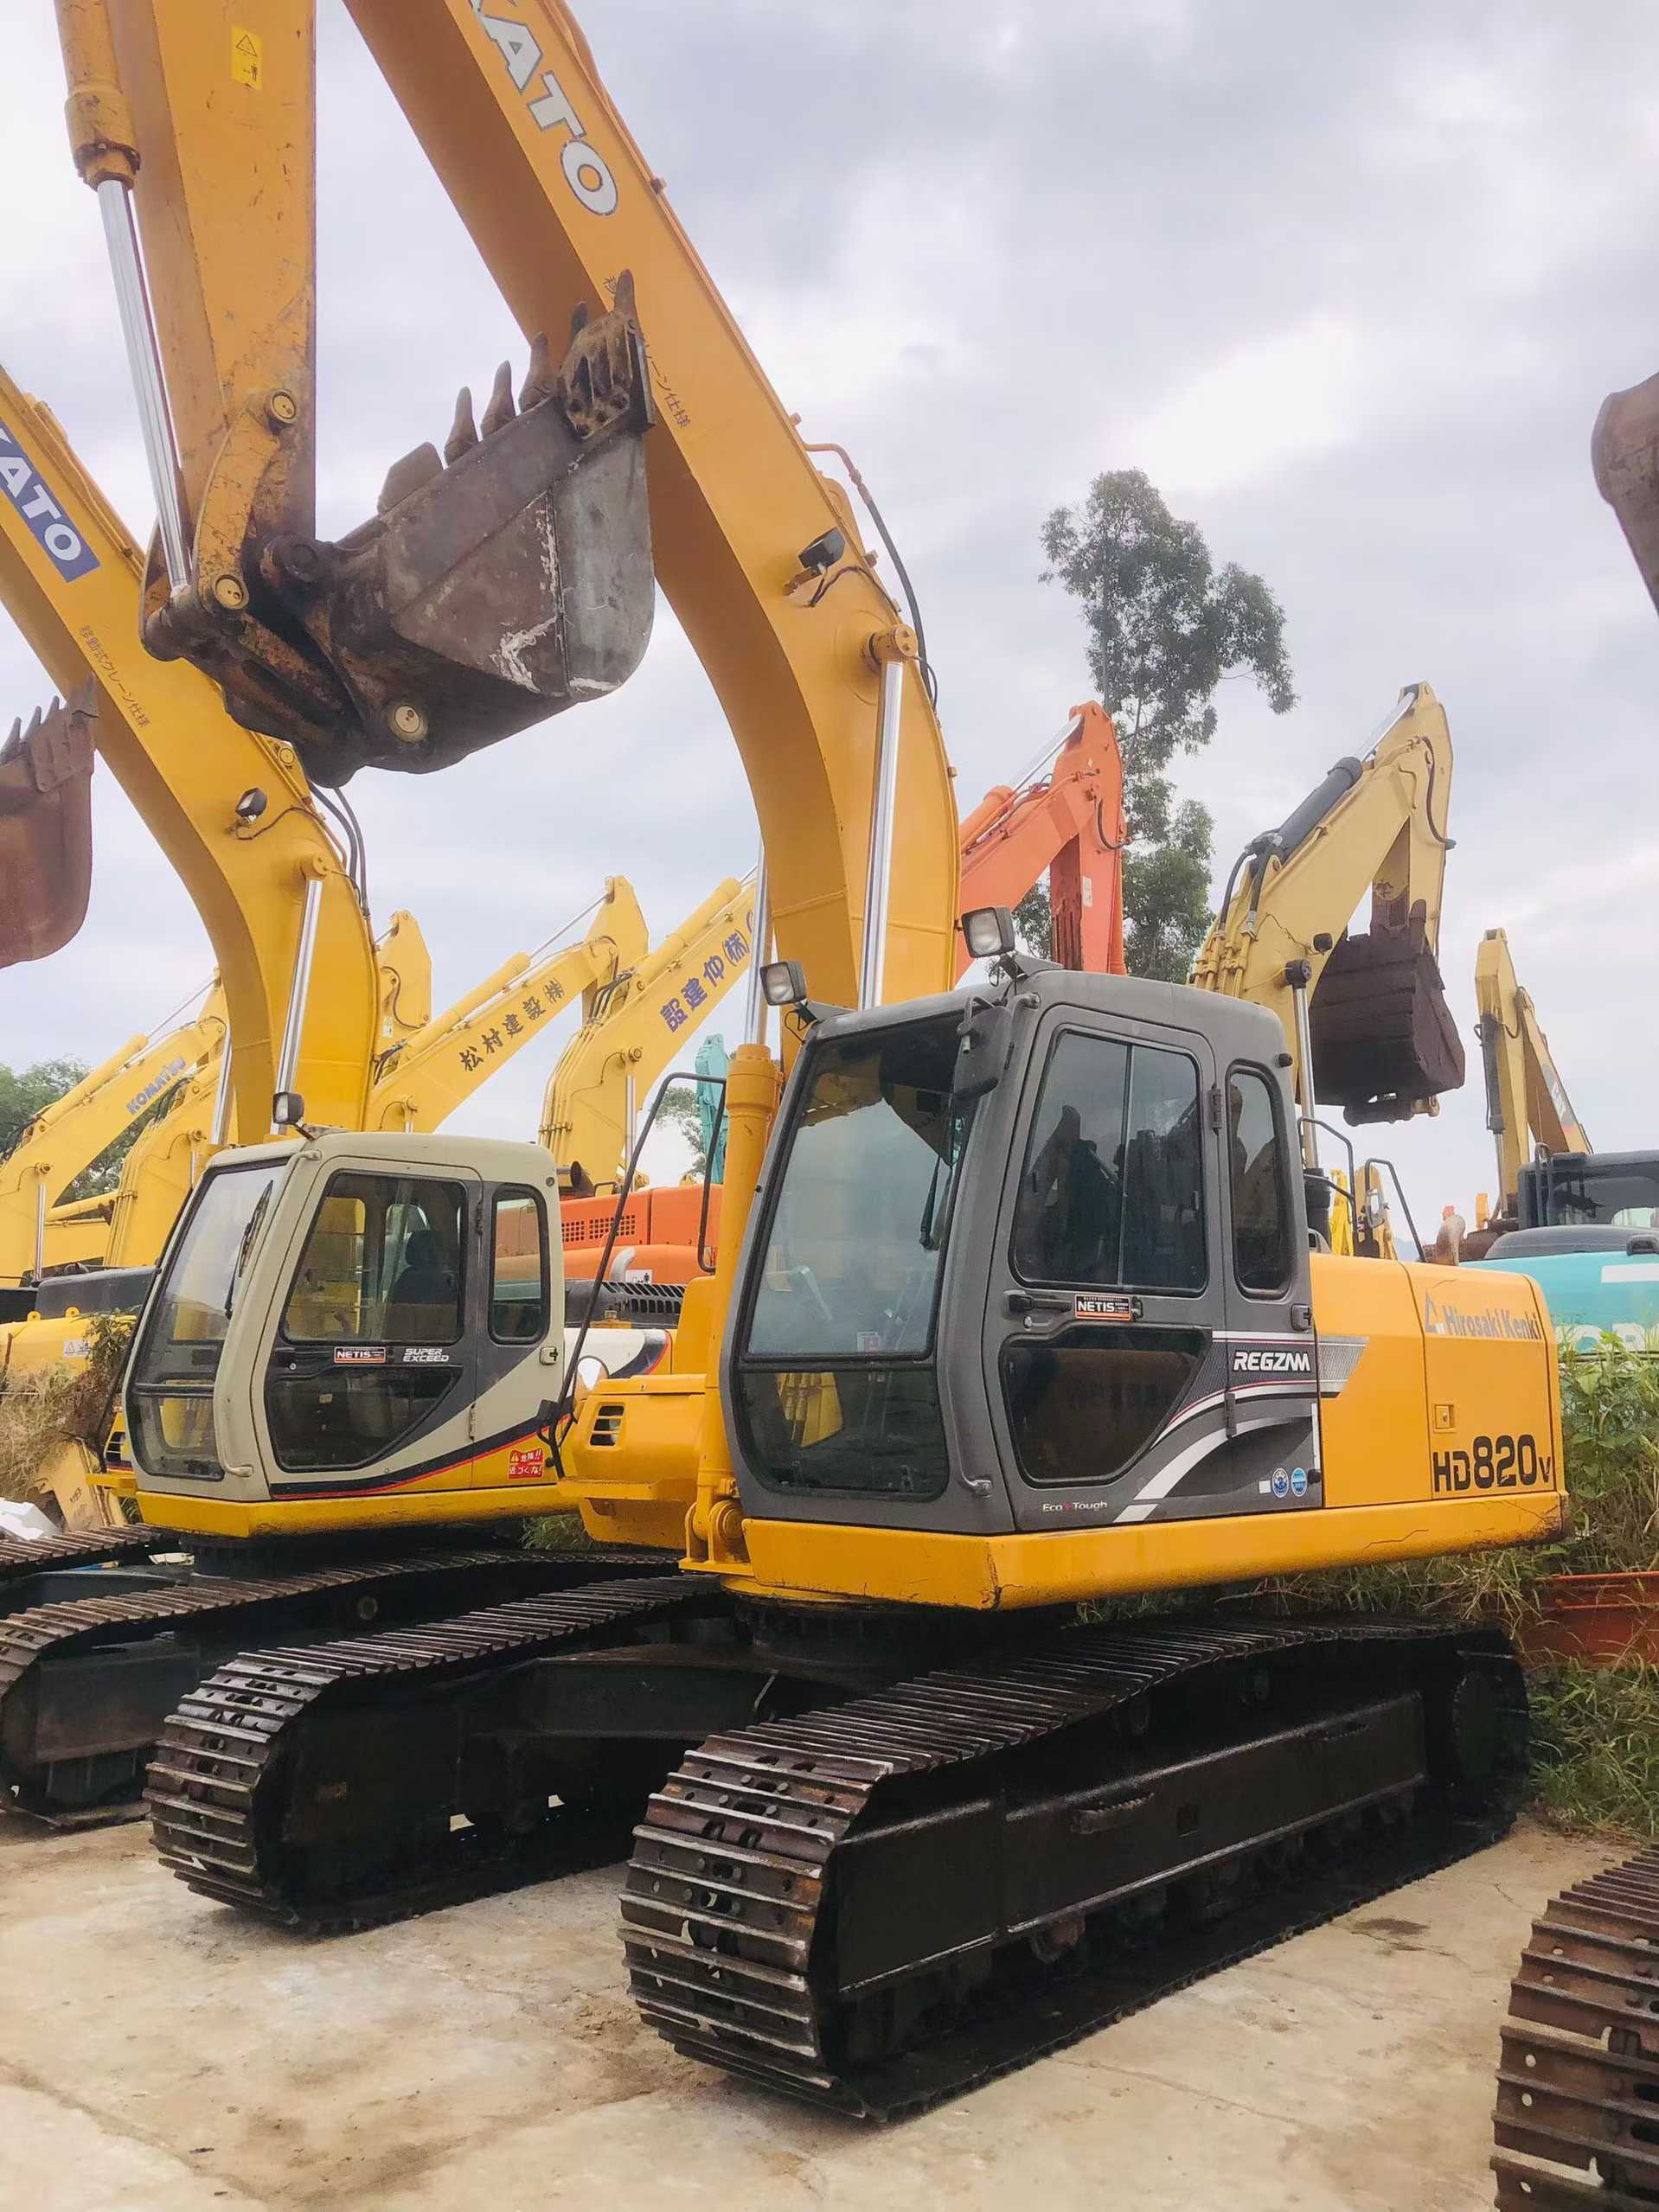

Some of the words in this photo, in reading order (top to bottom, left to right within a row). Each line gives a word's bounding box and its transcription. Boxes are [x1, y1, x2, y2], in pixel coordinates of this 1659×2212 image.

[468, 0, 618, 216] ATO
[0, 428, 82, 561] ATO
[1078, 1301, 1115, 1313] NETIS
[1442, 1305, 1502, 1339] Hirosaki
[1499, 1308, 1542, 1340] Kenki
[1042, 1503, 1063, 1512] Eco
[1072, 1500, 1108, 1512] Tough
